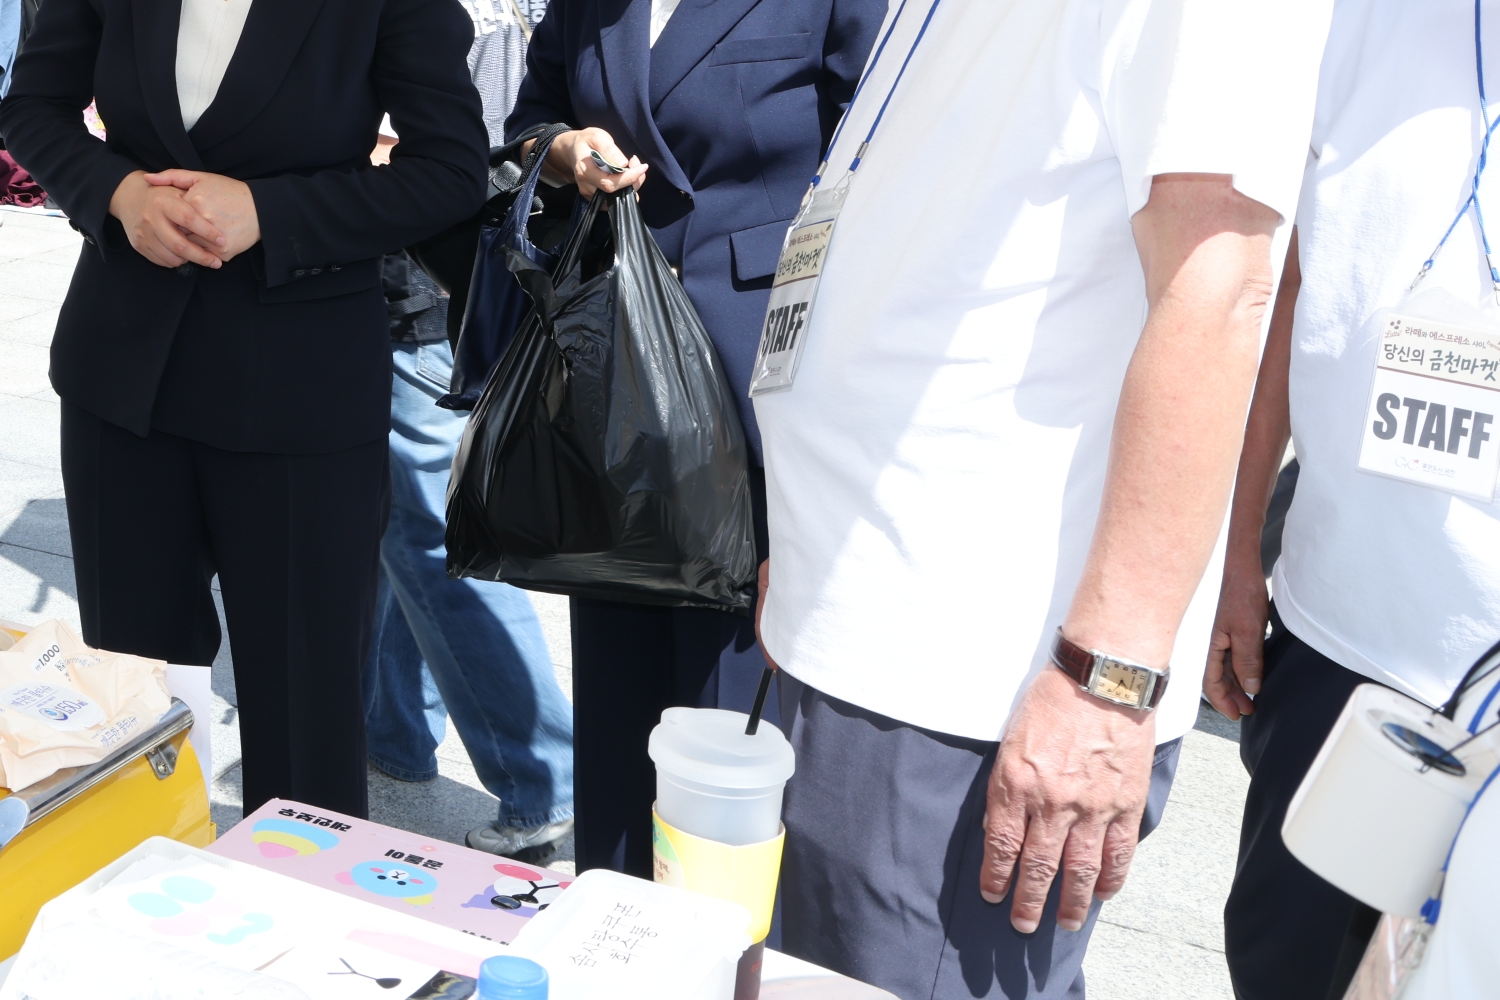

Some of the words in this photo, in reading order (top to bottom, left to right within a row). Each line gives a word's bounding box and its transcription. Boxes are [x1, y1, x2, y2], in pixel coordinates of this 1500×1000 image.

[791, 248, 822, 277] 금천마켓
[762, 301, 809, 357] STAFF
[1404, 326, 1428, 339] 라떼와
[1428, 330, 1470, 346] 에스프레소
[1383, 343, 1425, 366] 당신의
[1429, 349, 1499, 382] 금천마켓
[1372, 392, 1494, 460] STAFF
[278, 807, 352, 833] 레인보우
